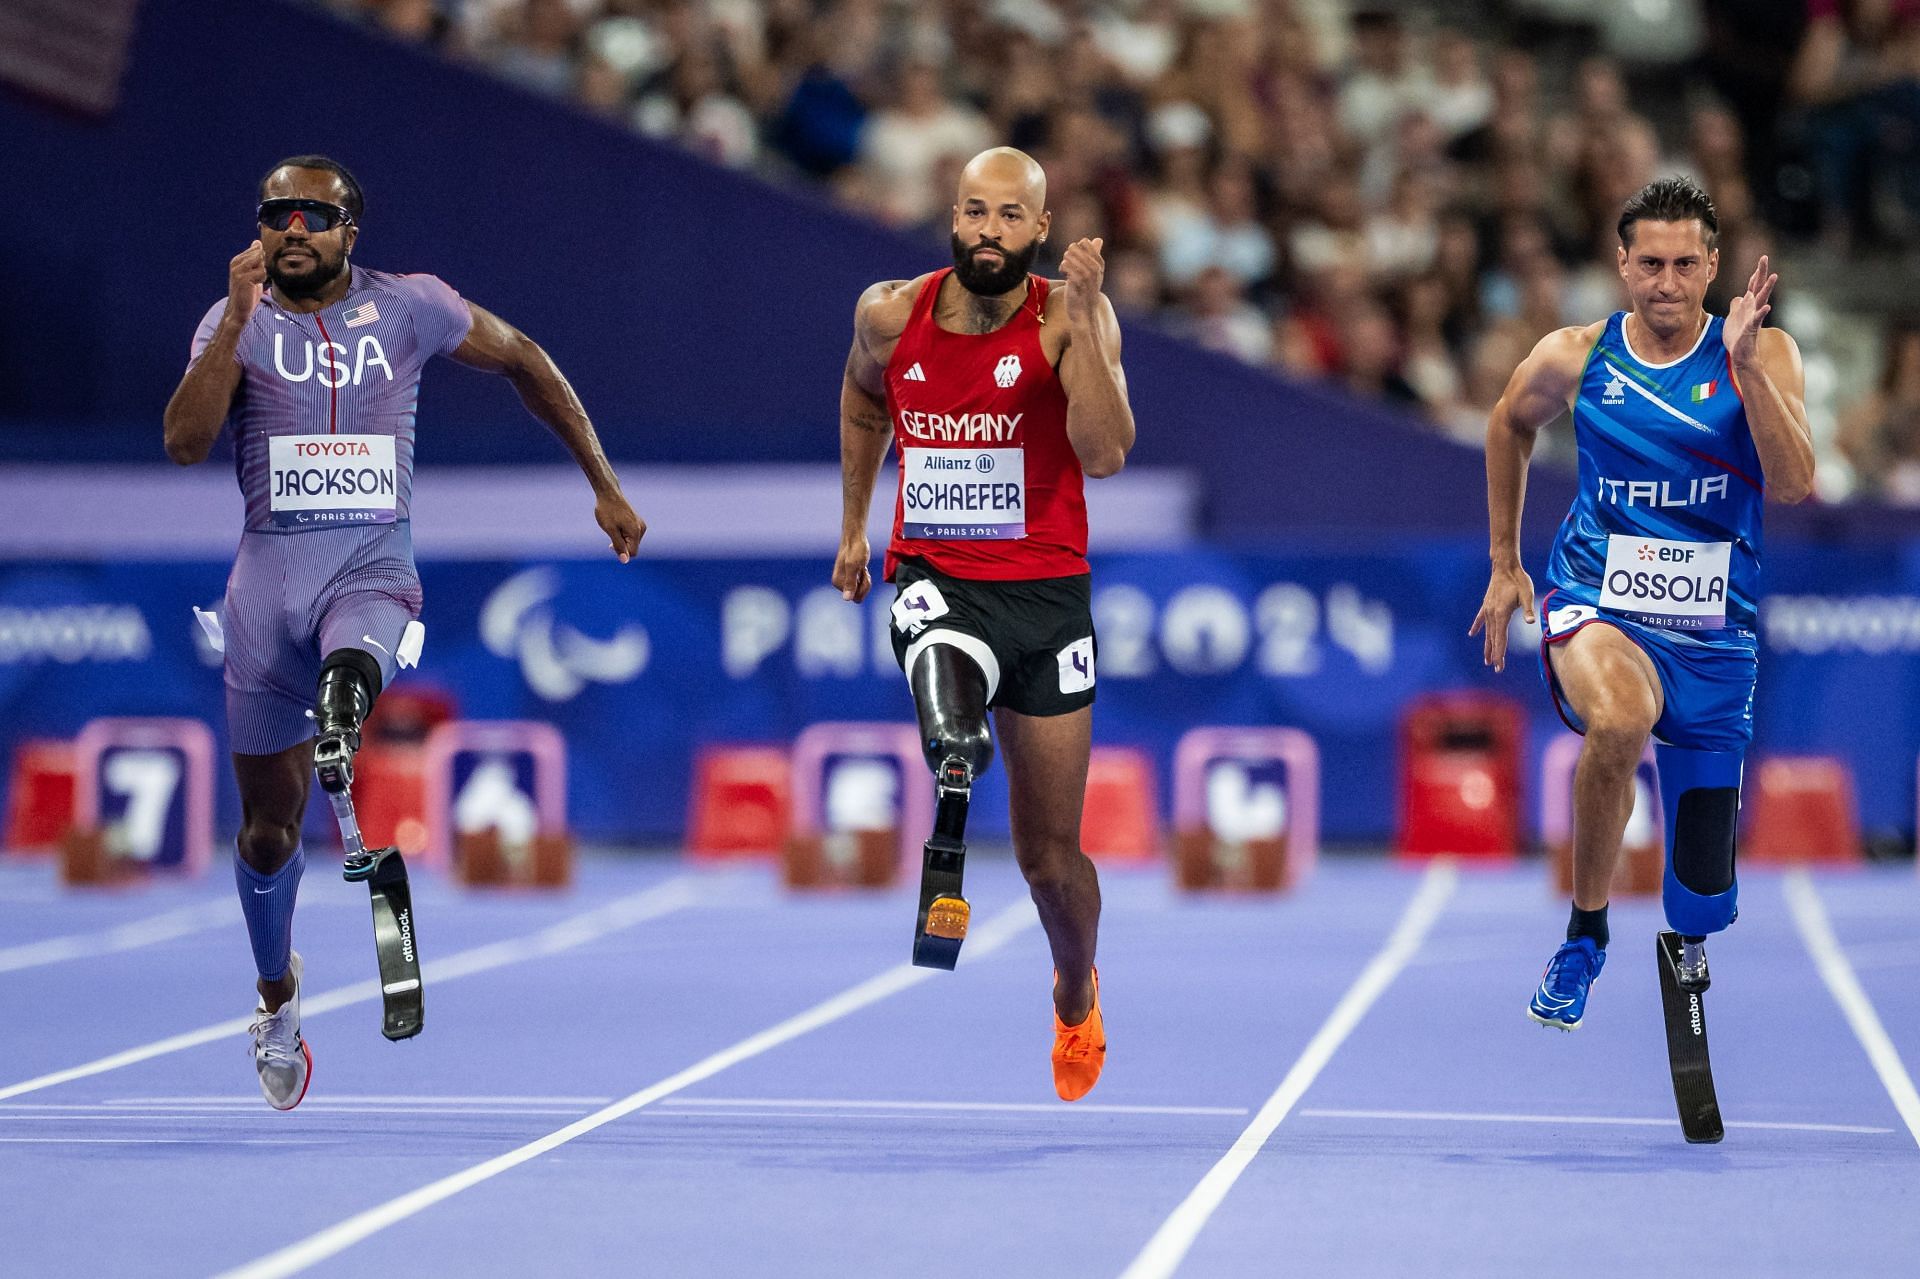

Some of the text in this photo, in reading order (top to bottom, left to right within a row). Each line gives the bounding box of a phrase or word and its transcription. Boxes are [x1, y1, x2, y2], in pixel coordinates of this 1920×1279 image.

[275, 333, 393, 388] USA
[900, 410, 1023, 441] GERMANY
[295, 443, 370, 456] TOYOTA
[924, 456, 971, 470] Allianz
[275, 468, 394, 497] JACKSON
[906, 483, 1020, 510] SCHAEFER
[1599, 474, 1728, 507] ITALIA
[937, 527, 998, 536] PARIS 2024
[1608, 570, 1724, 602] OSSOLA
[1642, 616, 1703, 627] PARIS 2024
[1072, 651, 1088, 679] 4
[105, 750, 179, 858] 7
[1689, 994, 1702, 1036] ottobo
